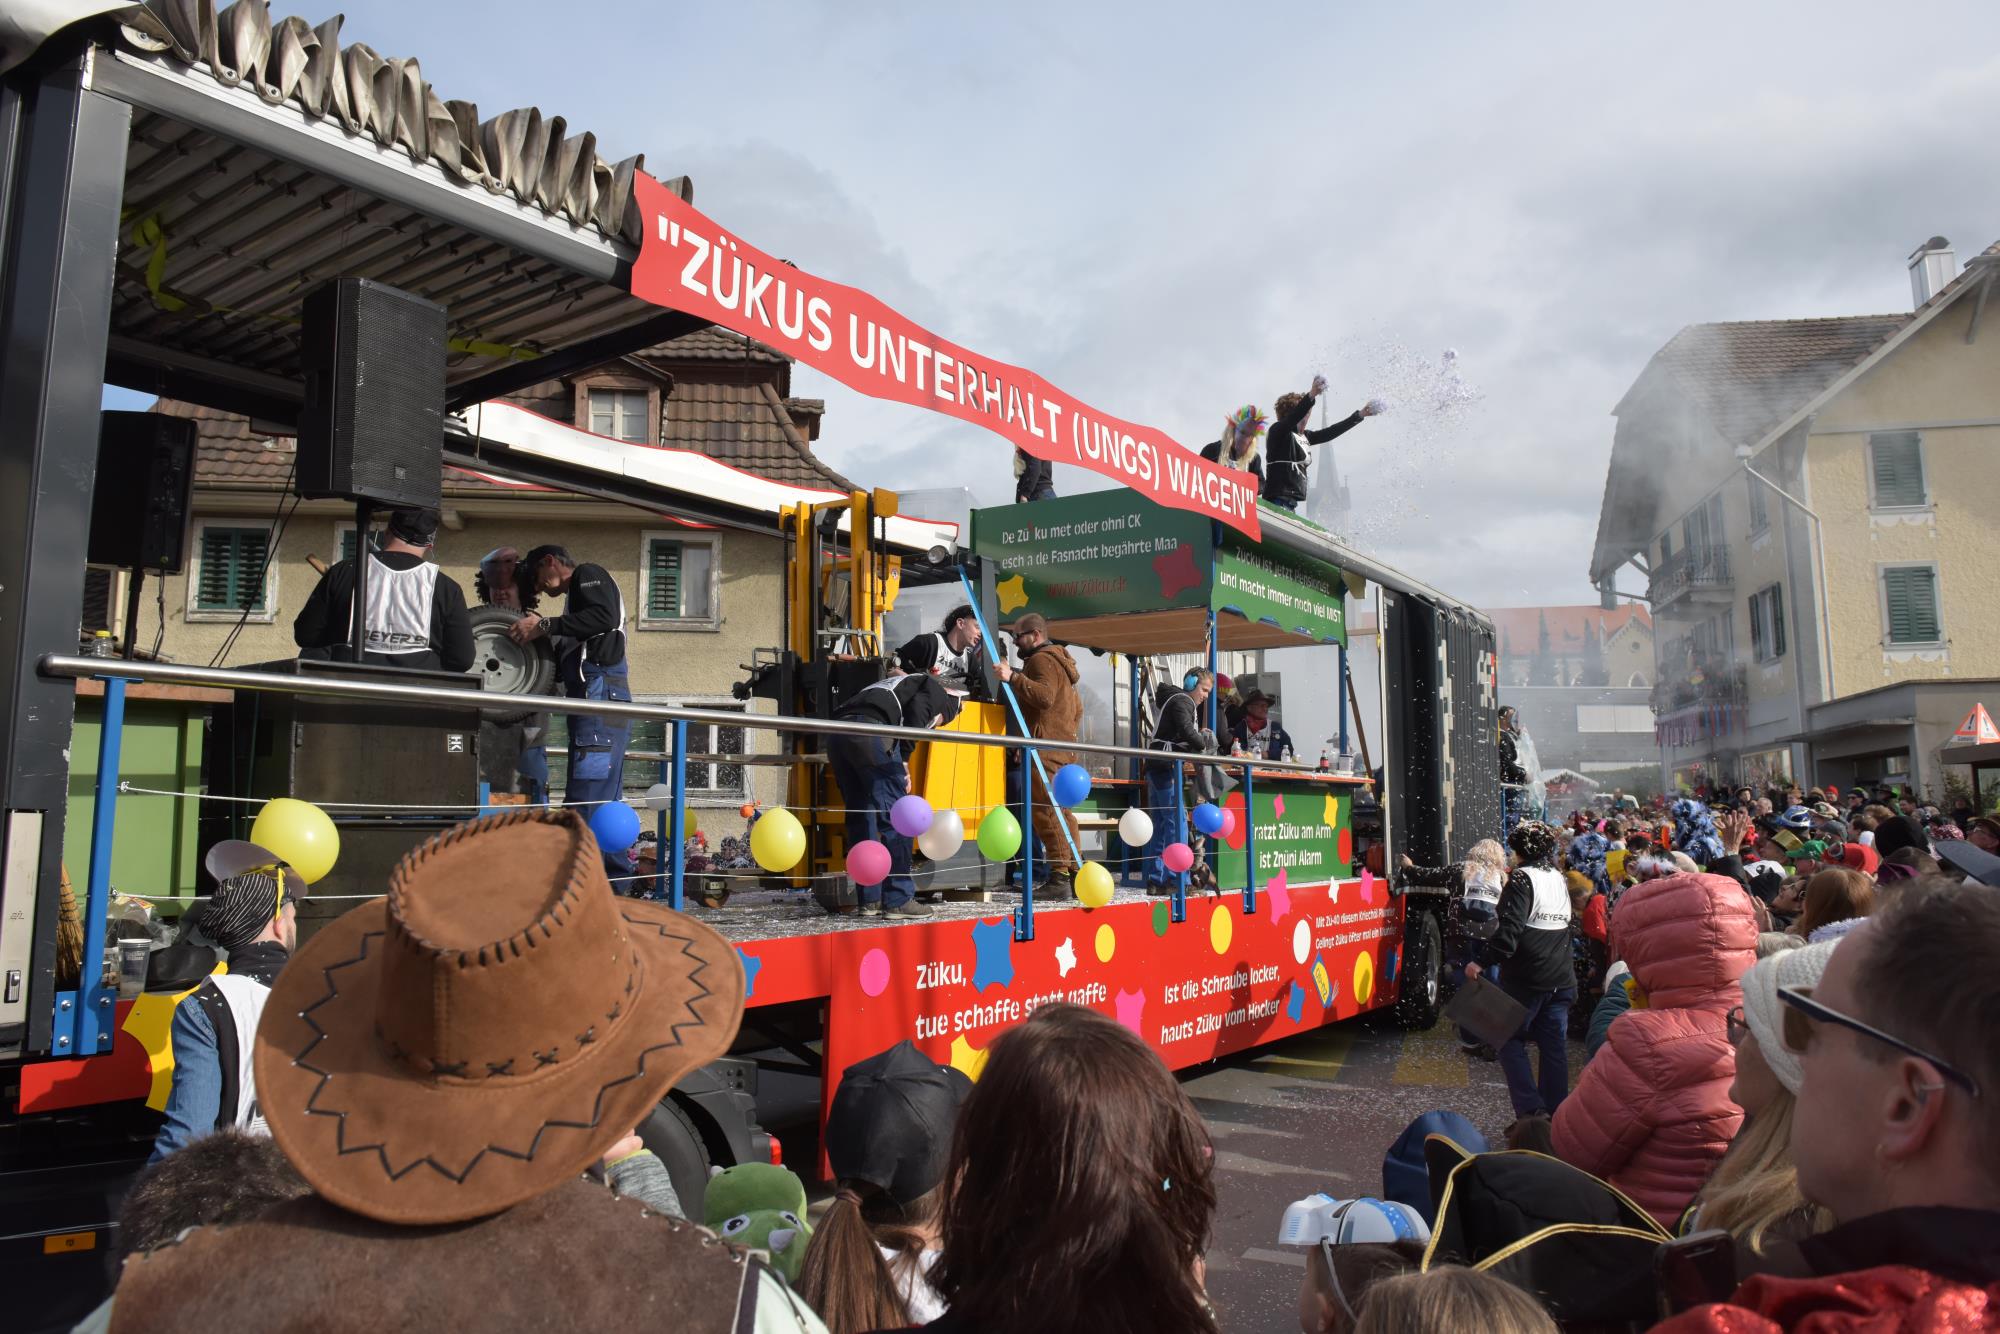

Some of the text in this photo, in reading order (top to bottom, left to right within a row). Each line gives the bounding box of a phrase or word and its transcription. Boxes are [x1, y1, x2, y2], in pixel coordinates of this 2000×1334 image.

[658, 215, 1253, 519] "ZÜKUS UNTERHALT (UNGS) WAGEN"
[1003, 530, 1015, 544] De
[1050, 522, 1071, 538] met
[1074, 520, 1099, 535] oder
[1101, 515, 1125, 531] ohni
[1127, 513, 1142, 528] CK
[1002, 537, 1178, 569] esch a de Fasnacht begährte Maa
[1220, 571, 1341, 623] und macht immer noch viel MIST
[1251, 823, 1331, 840] ratzt Züku am Arm
[1259, 849, 1322, 869] ist Znüni Alarm
[916, 961, 967, 990] Züku,
[1164, 965, 1280, 1004] Ist die Schraube locker,
[915, 1014, 948, 1040] tue
[954, 998, 1020, 1032] schaffe
[1161, 1020, 1193, 1045] hauts
[1196, 1013, 1222, 1035] Züku
[1224, 1007, 1246, 1027] vom
